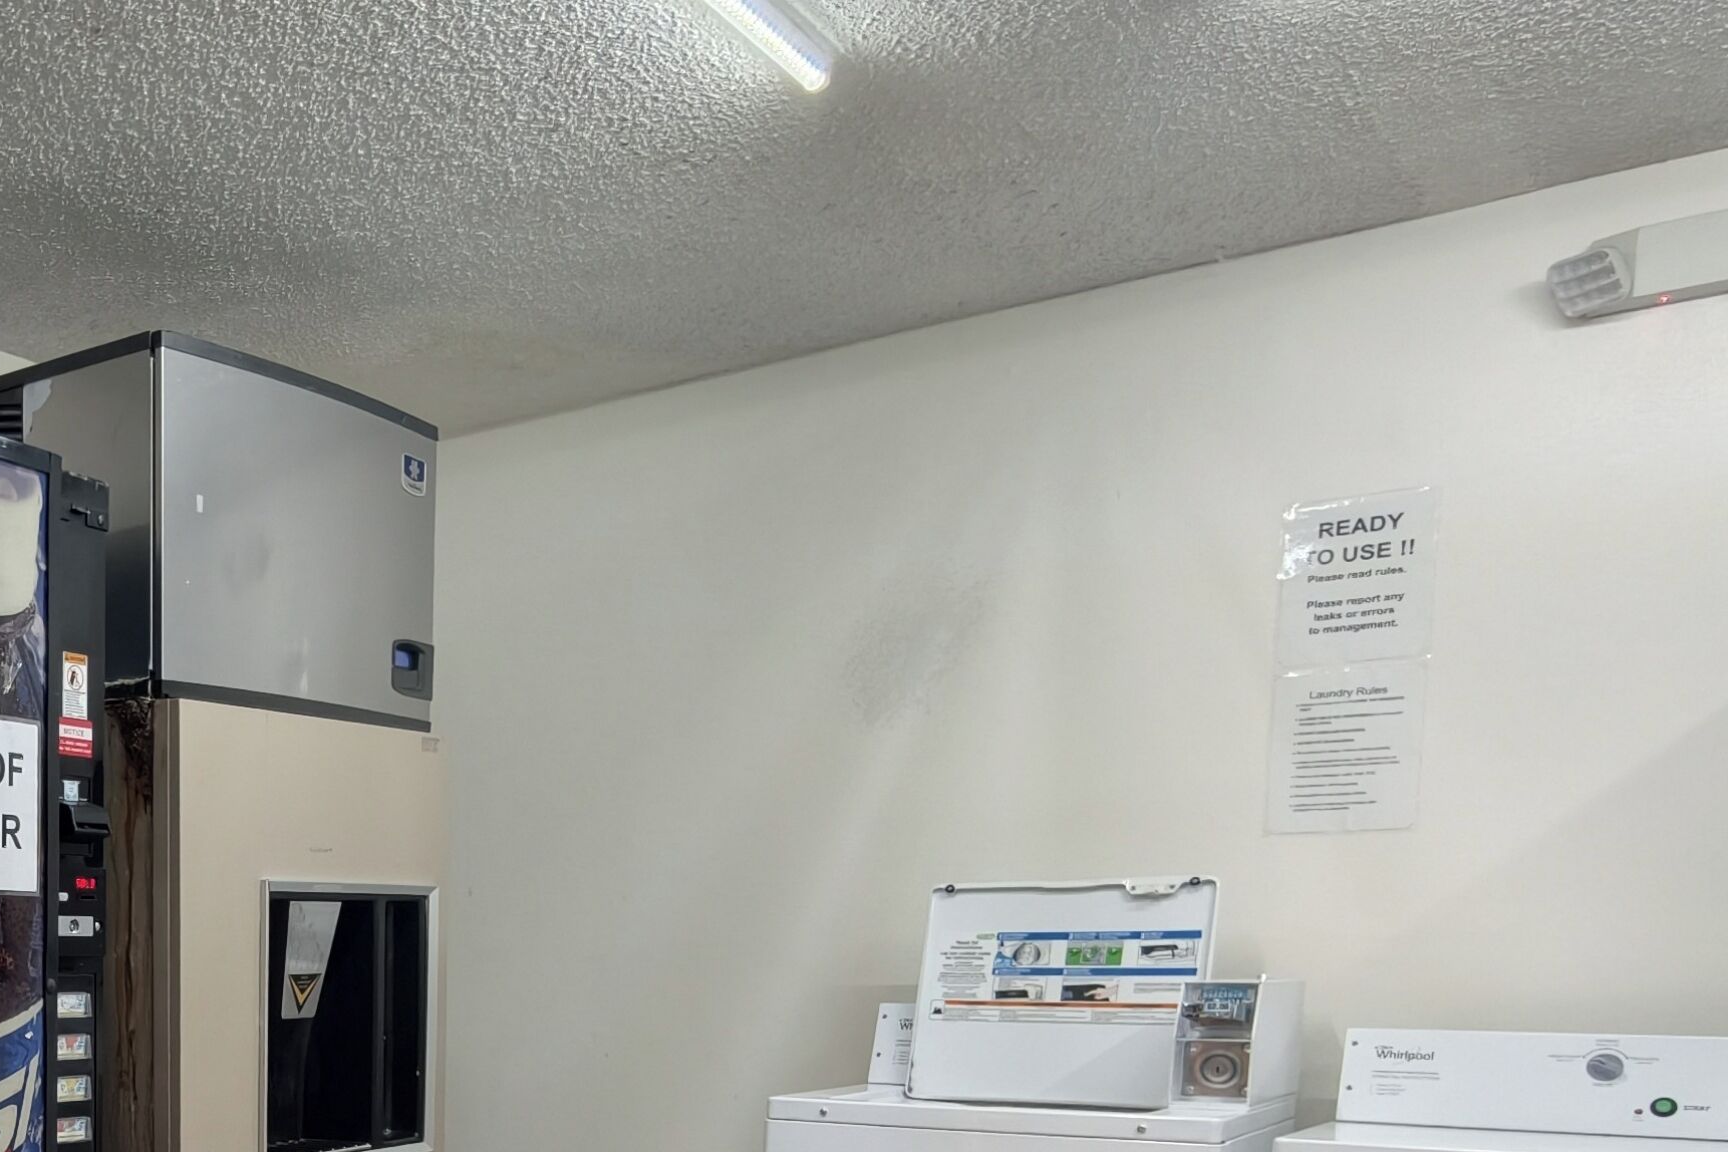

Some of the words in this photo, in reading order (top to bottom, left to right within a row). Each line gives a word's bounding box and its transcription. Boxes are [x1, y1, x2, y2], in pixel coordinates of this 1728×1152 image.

[1318, 512, 1404, 539] READY
[1343, 541, 1392, 562] USE
[1401, 538, 1415, 556] !!
[1308, 573, 1344, 584] Please
[1347, 569, 1372, 579] read
[1375, 566, 1407, 576] rules.
[1307, 599, 1343, 609] Please
[1346, 594, 1381, 606] report
[1383, 592, 1405, 602] any
[1313, 611, 1342, 621] leaks
[1346, 610, 1359, 618] or
[1361, 607, 1395, 616] errors
[1308, 626, 1320, 635] to
[1323, 619, 1399, 633] management.
[1309, 688, 1354, 699] Laundry
[1356, 686, 1388, 696] Rules
[1376, 1050, 1435, 1062] Whirlpool
